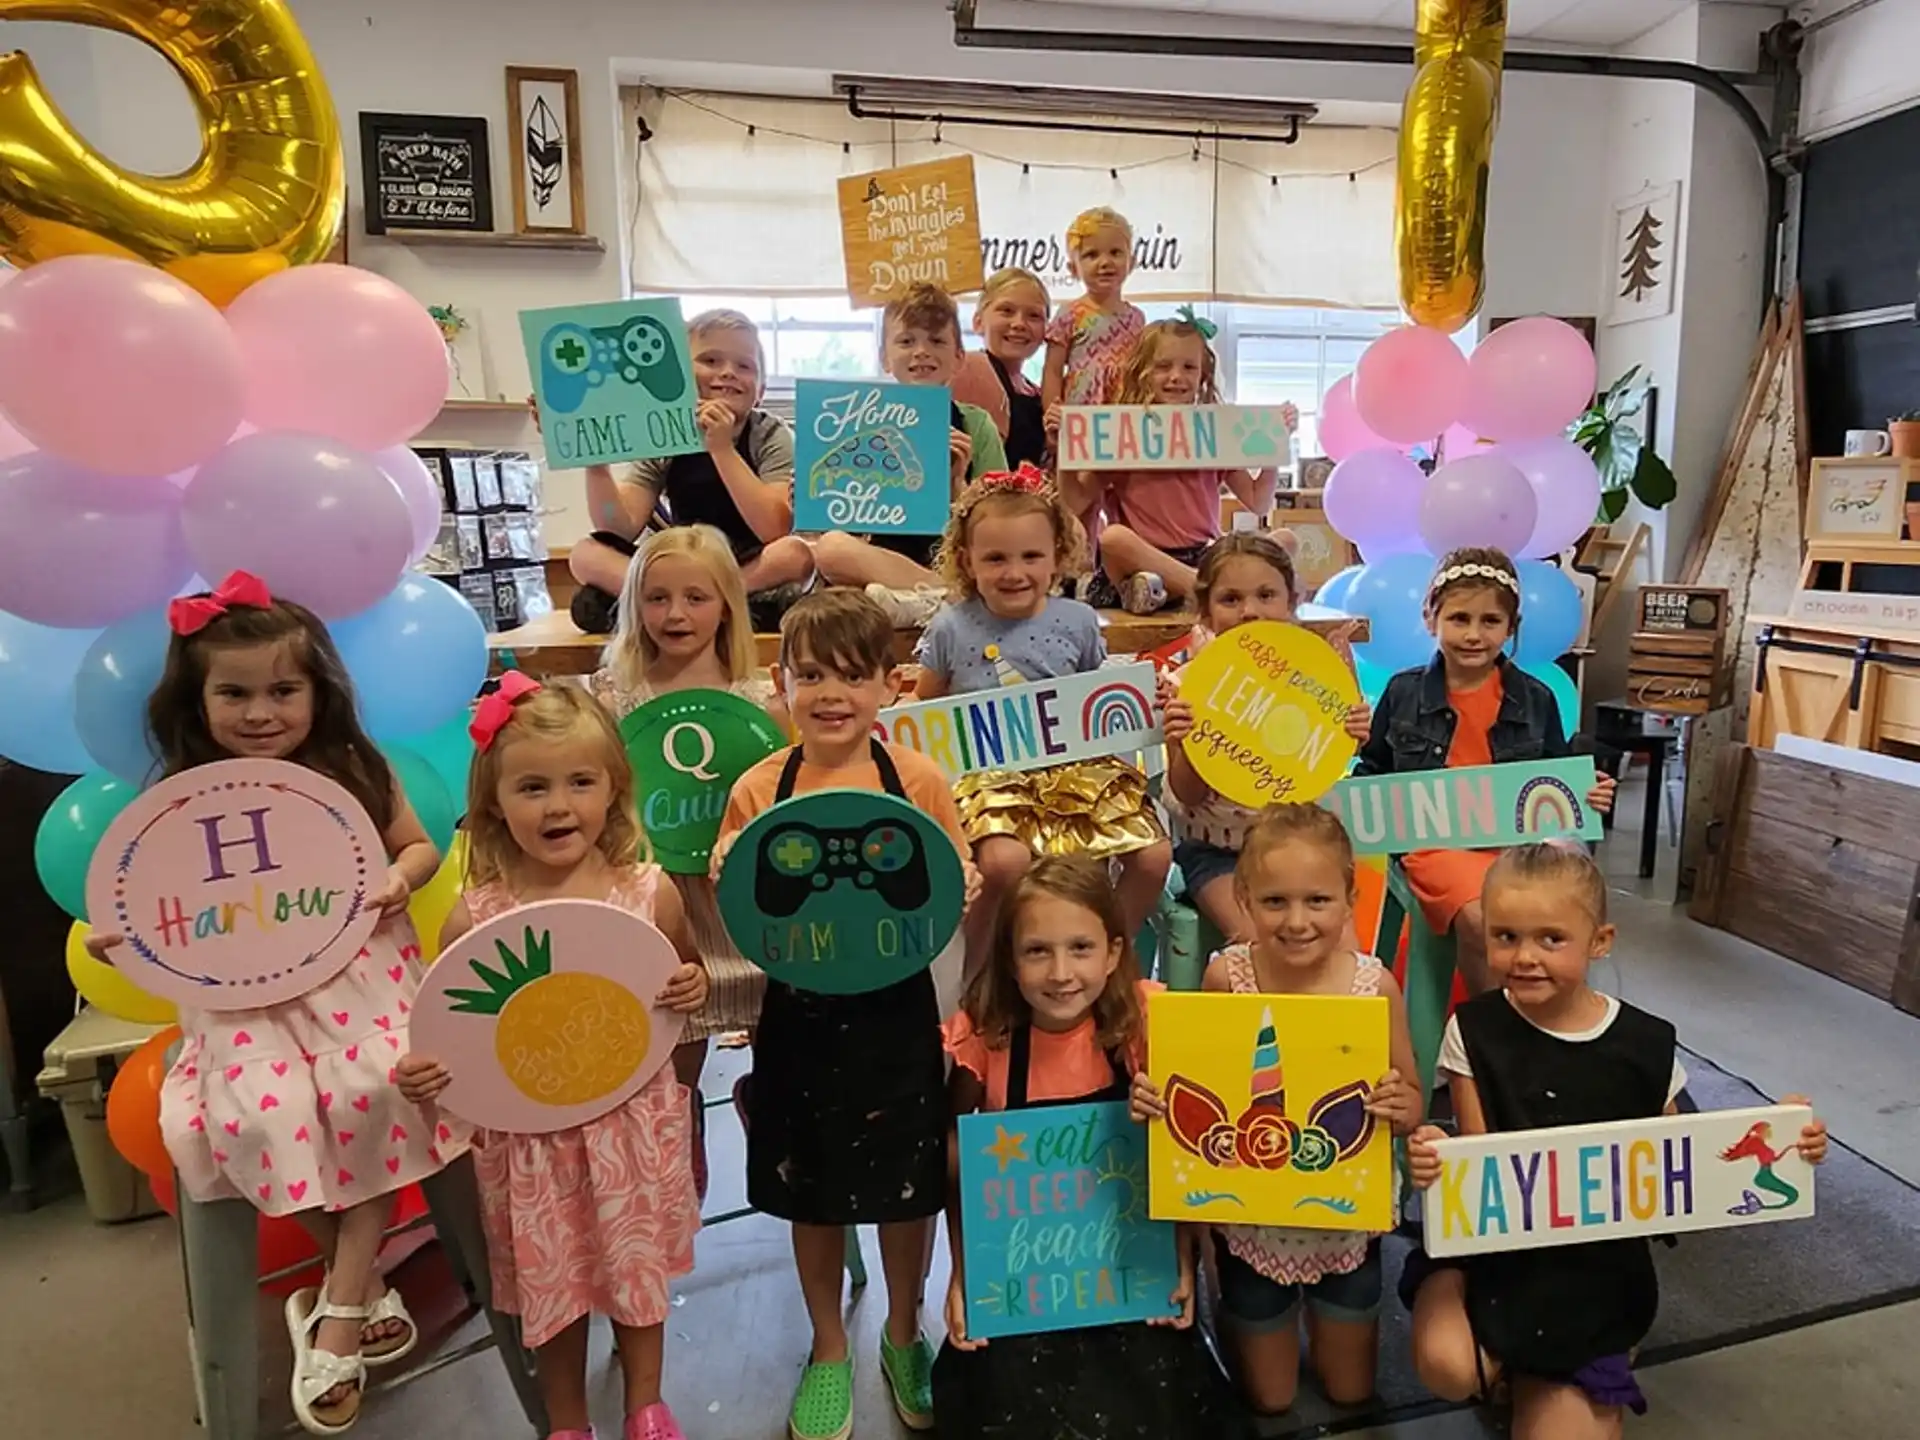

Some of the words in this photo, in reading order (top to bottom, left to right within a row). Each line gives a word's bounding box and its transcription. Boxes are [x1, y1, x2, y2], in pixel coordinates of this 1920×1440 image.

[432, 145, 464, 170] BATH
[439, 184, 473, 196] wine
[866, 183, 917, 222] Don't
[868, 222, 888, 241] the
[891, 240, 914, 263] get
[917, 234, 948, 257] you
[1134, 223, 1182, 272] ain
[868, 257, 949, 295] Down
[554, 413, 633, 459] GAME
[646, 407, 699, 449] ON!
[813, 388, 920, 443] Home
[1065, 410, 1218, 462] REAGAN
[818, 479, 907, 526] Slice
[1645, 592, 1689, 607] BEER
[1238, 633, 1290, 679] easy
[663, 722, 720, 780] Q
[870, 689, 1068, 773] ORINNE
[1192, 720, 1296, 799] squeezy
[1328, 775, 1496, 844] UINN
[193, 807, 283, 883] H
[154, 884, 345, 948] Harlow
[1034, 1109, 1131, 1168] eat
[983, 1169, 1096, 1220] SLEEP
[1440, 1135, 1694, 1240] KAYLEIGH
[1006, 1201, 1125, 1274] beach
[1006, 1266, 1132, 1317] REPEAT
